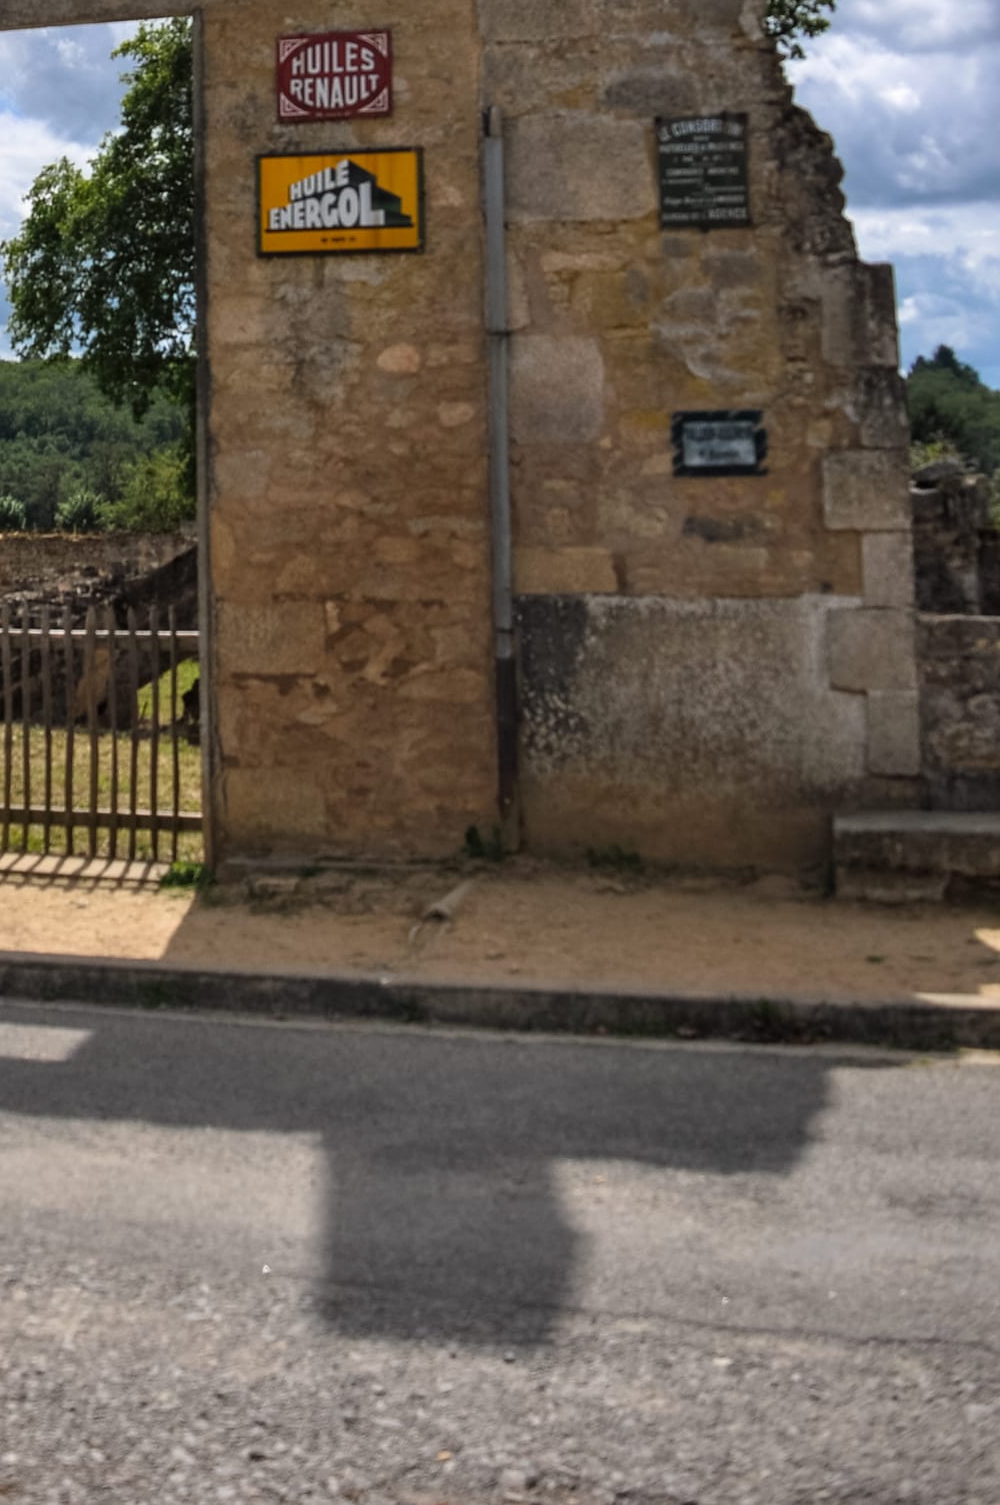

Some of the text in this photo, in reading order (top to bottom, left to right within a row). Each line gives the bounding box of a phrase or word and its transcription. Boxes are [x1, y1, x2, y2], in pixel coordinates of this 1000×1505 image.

[292, 41, 375, 75] HUILES
[290, 74, 380, 109] RENAULT
[290, 158, 350, 201] HUILE
[270, 180, 385, 231] ENERGOL
